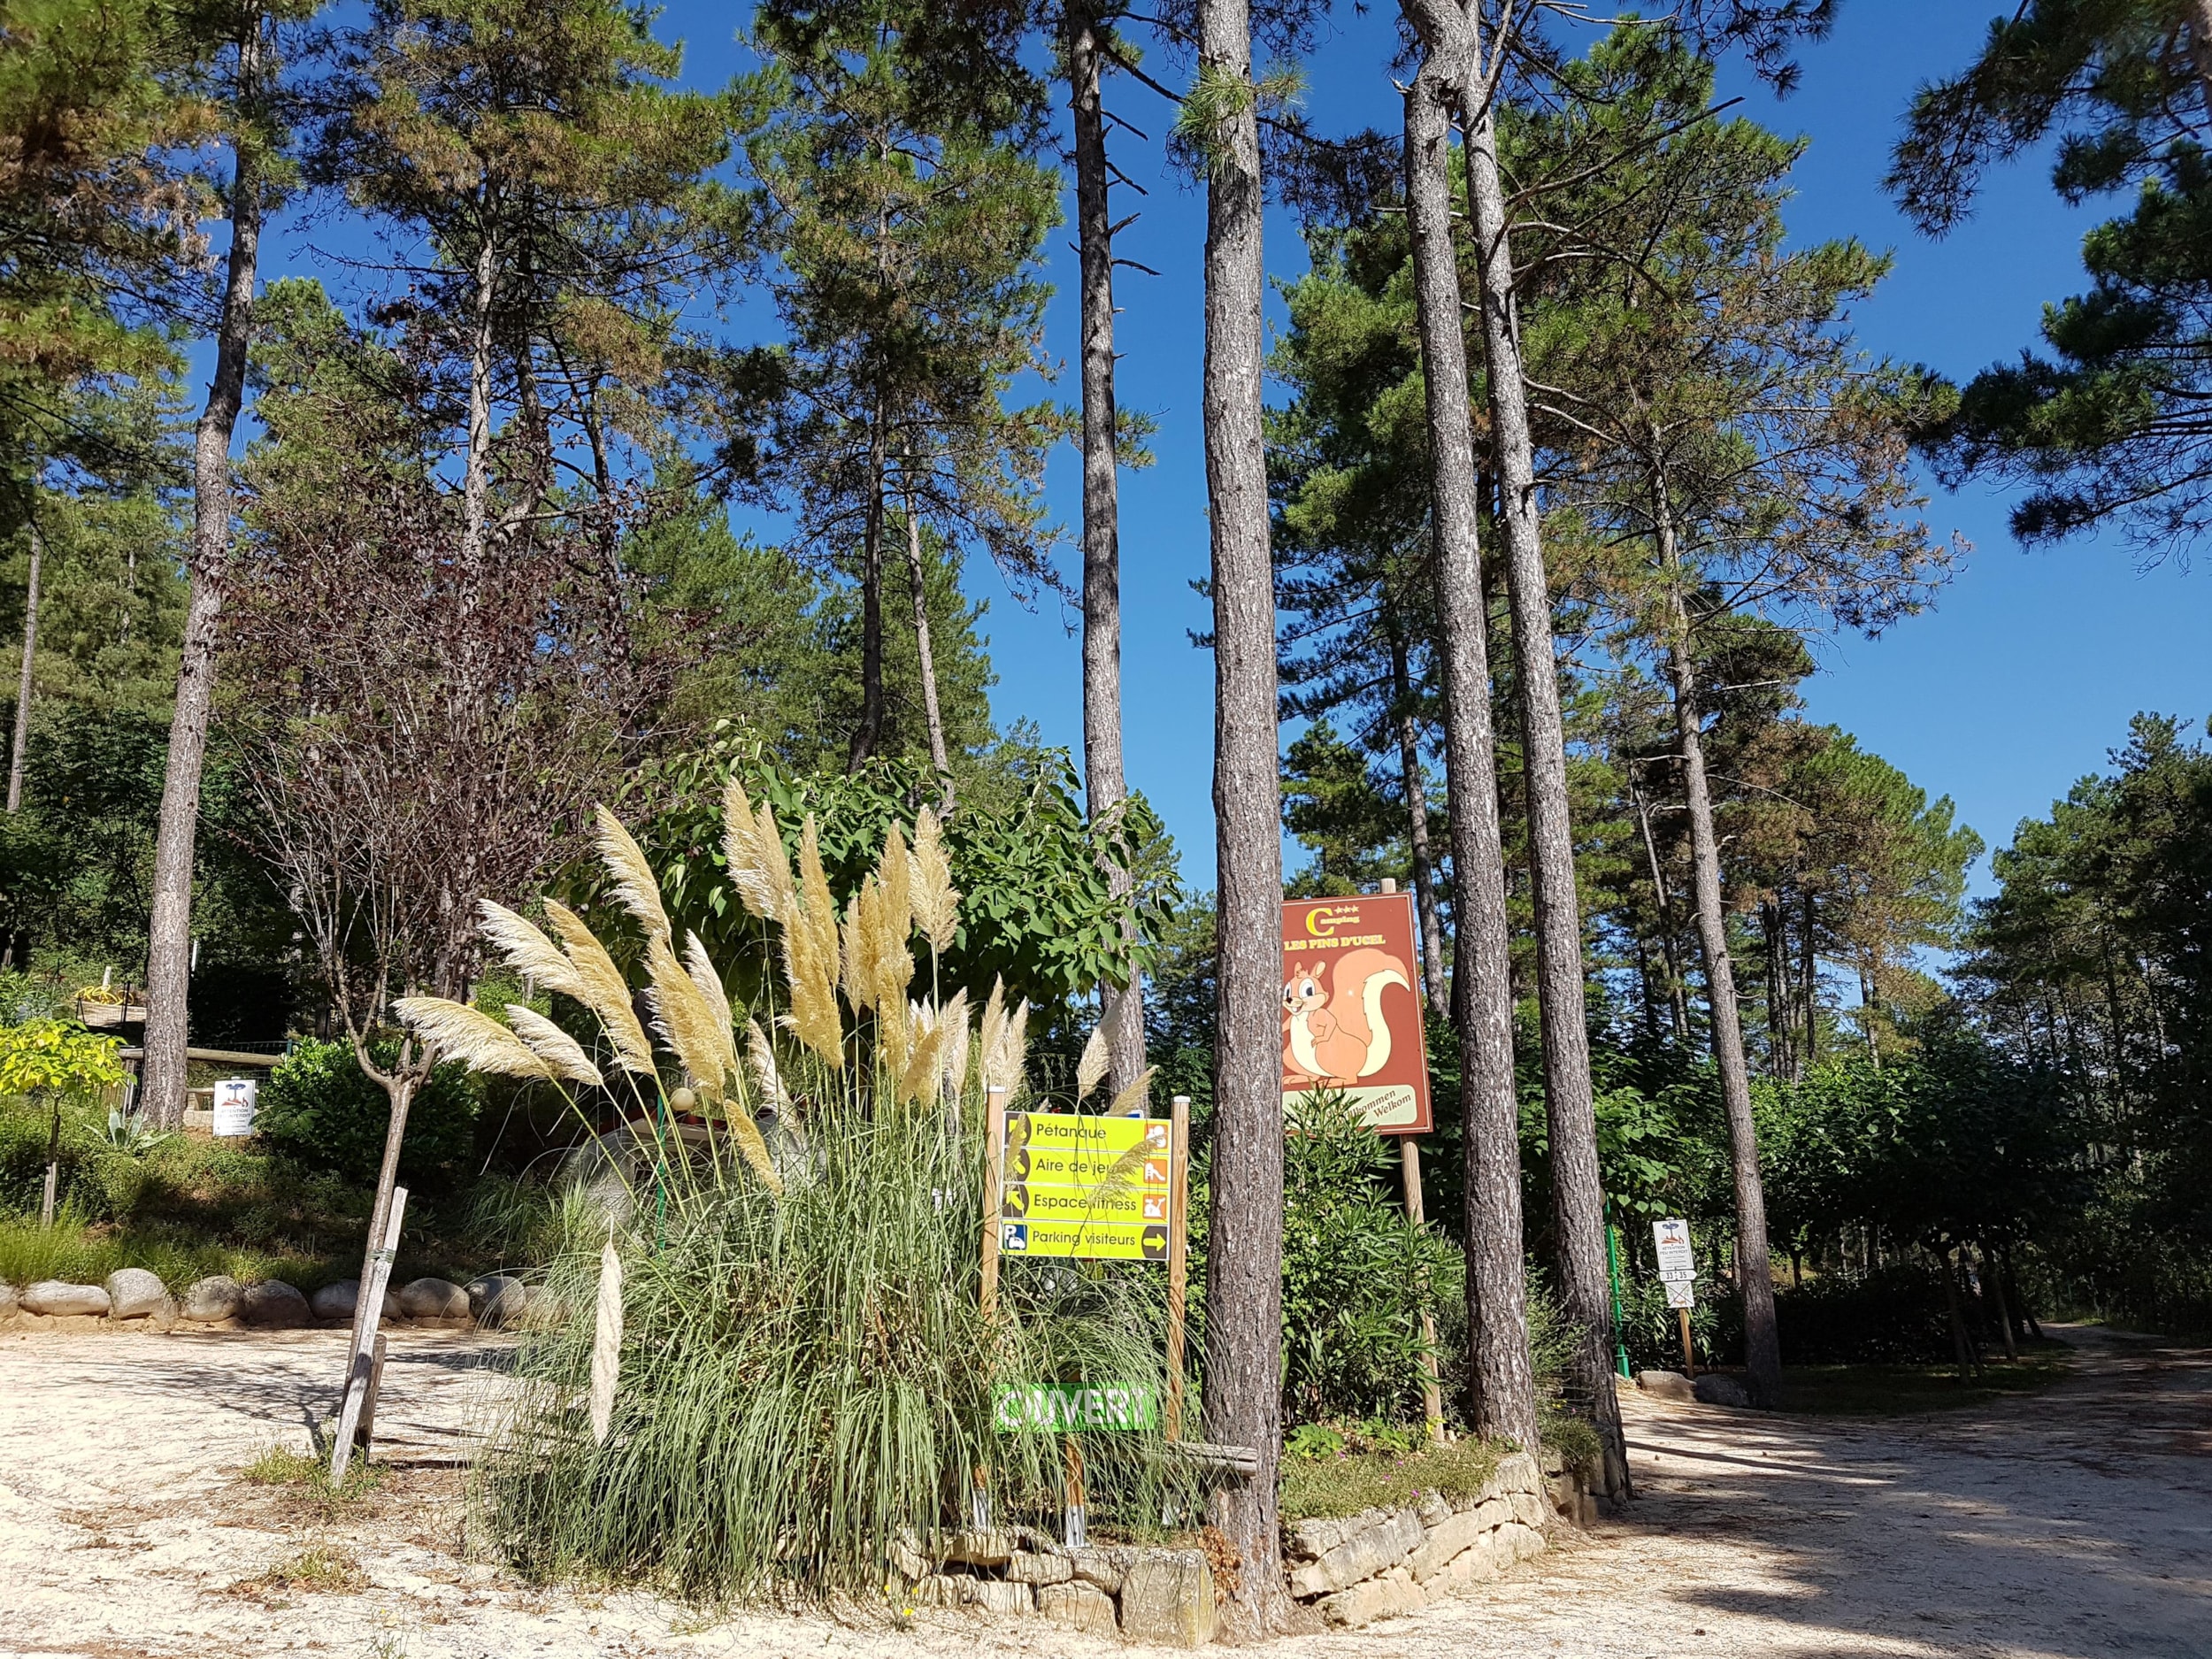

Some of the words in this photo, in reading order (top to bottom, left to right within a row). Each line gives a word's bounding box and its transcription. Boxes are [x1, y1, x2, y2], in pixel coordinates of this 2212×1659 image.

[1284, 940, 1308, 951] LES
[1308, 938, 1340, 949] PINS
[1373, 1094, 1412, 1118] Welkom
[1036, 1123, 1107, 1142] Pétanque
[1035, 1158, 1064, 1172] Aire
[1069, 1160, 1088, 1173] de
[1033, 1194, 1087, 1210] Espace
[1033, 1231, 1080, 1247] Parking
[1086, 1233, 1135, 1247] visiteurs
[1679, 1271, 1687, 1279] 35
[997, 1387, 1148, 1426] OUVERT
